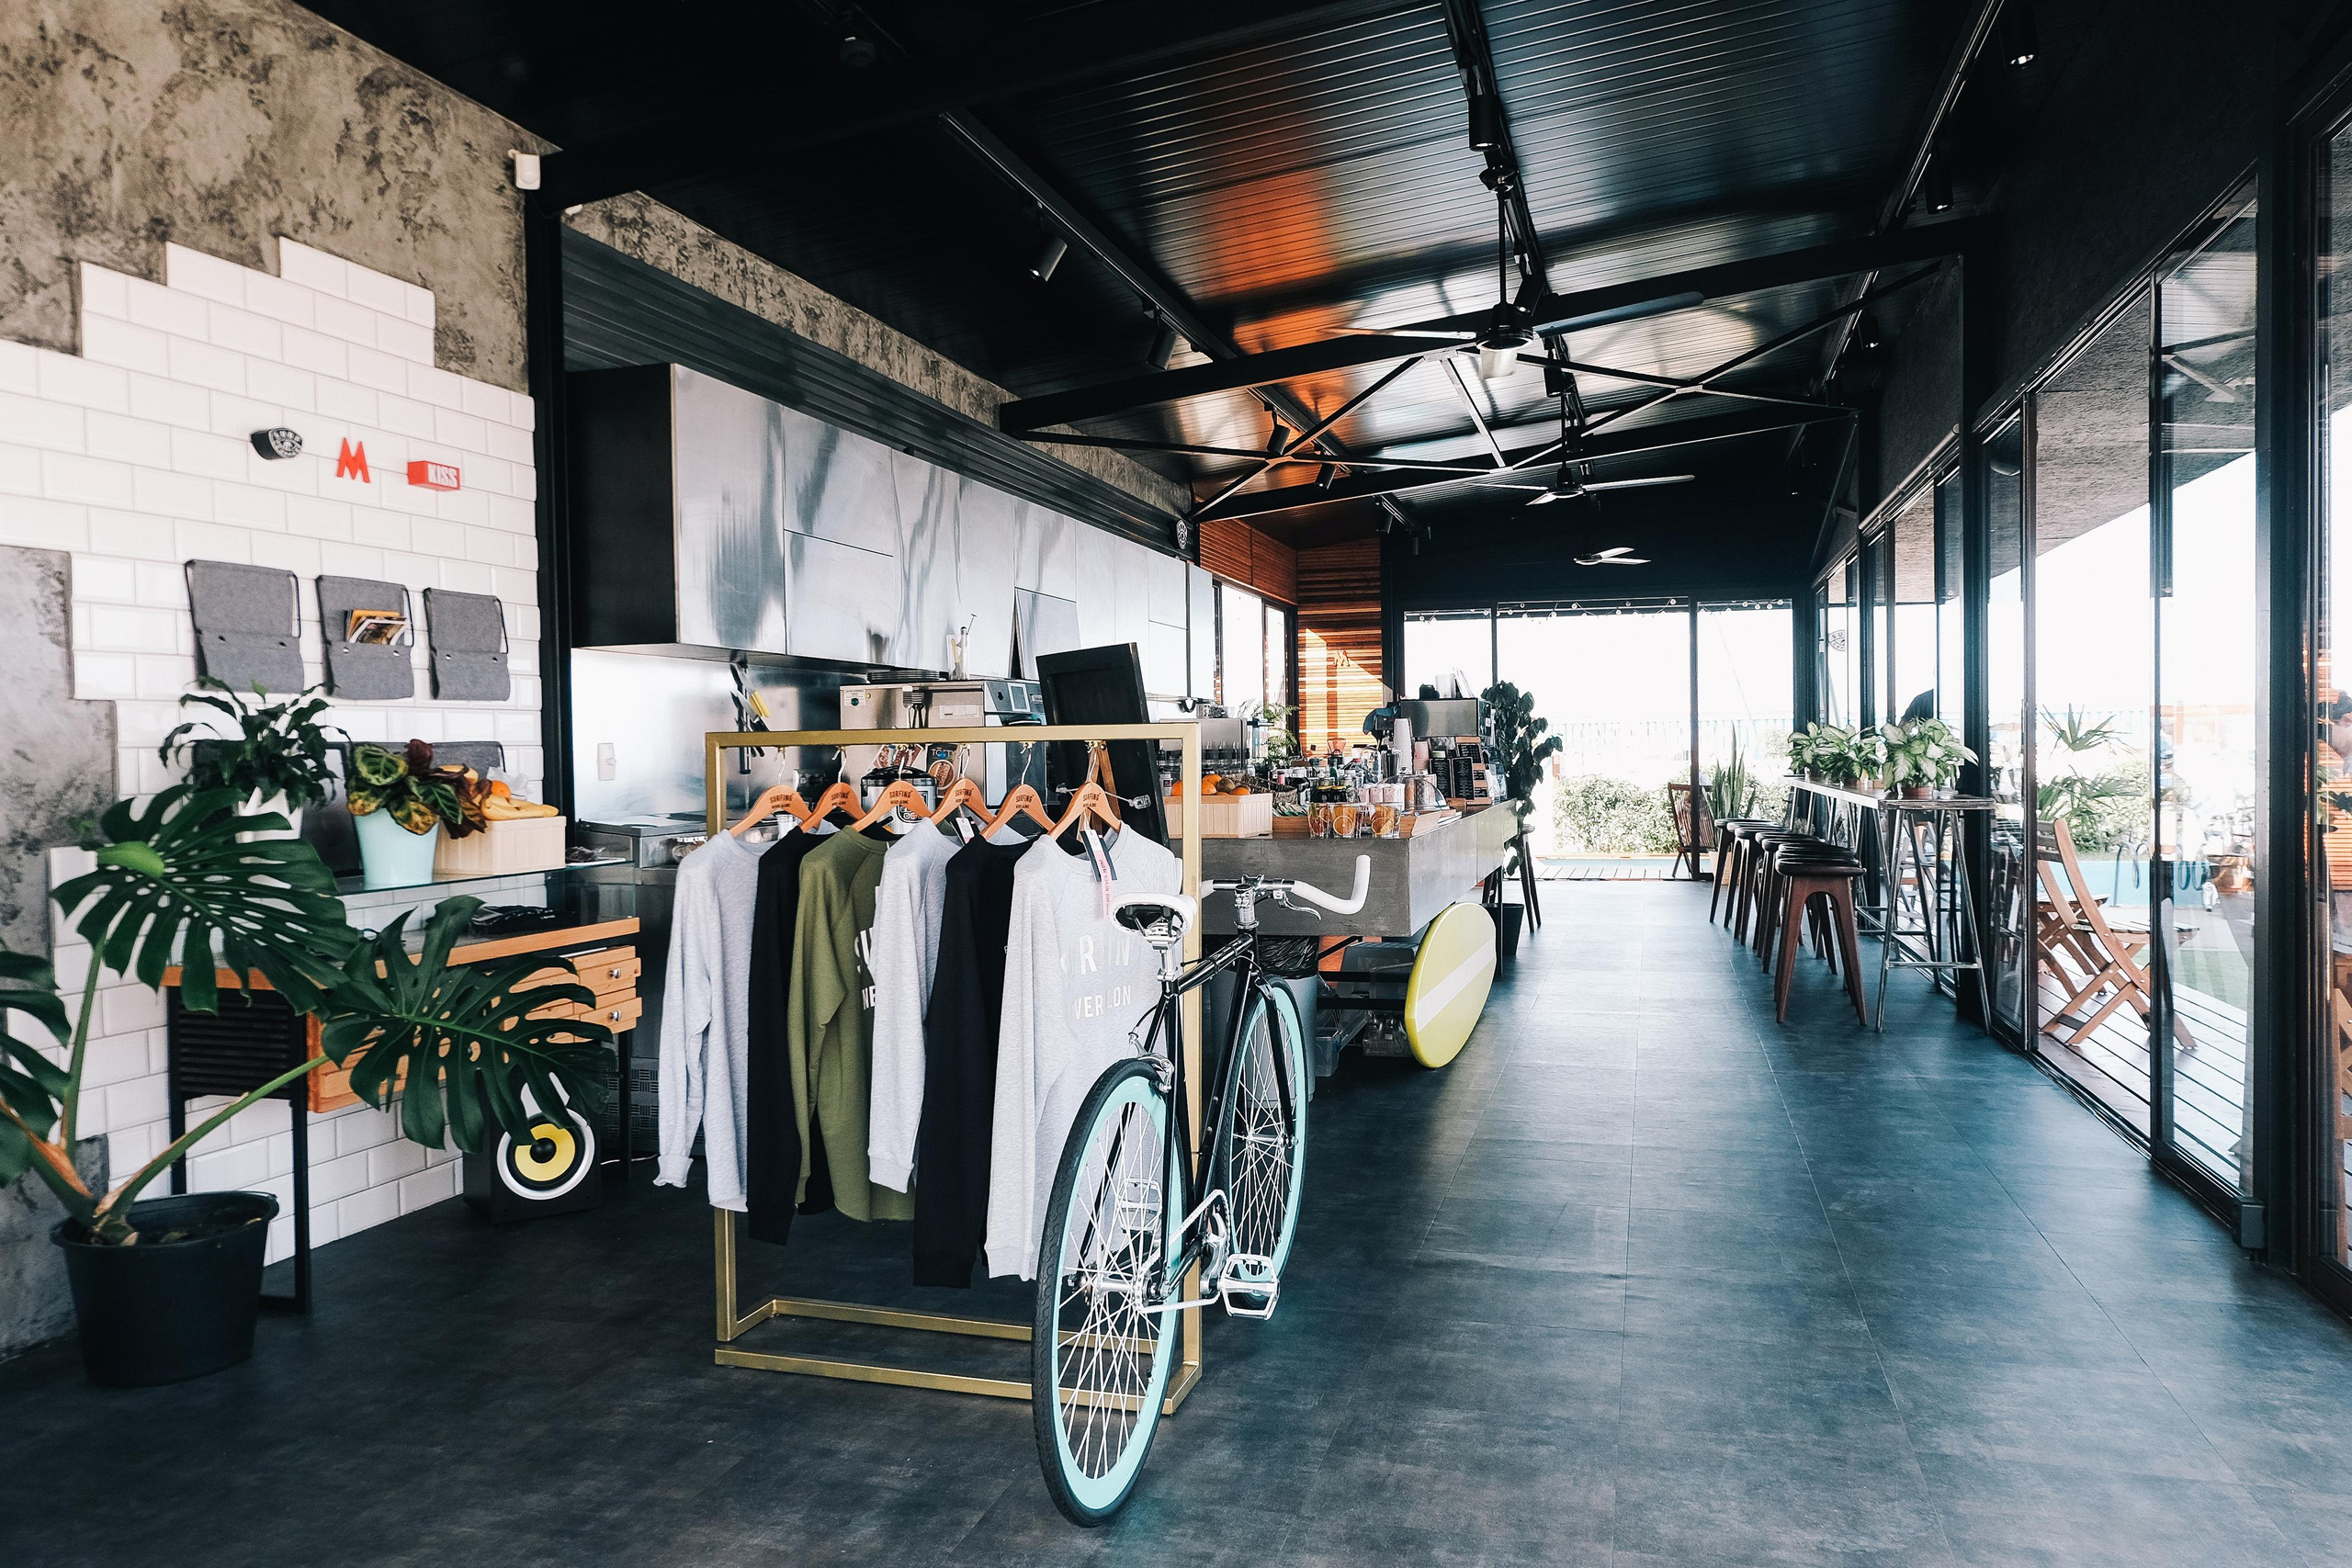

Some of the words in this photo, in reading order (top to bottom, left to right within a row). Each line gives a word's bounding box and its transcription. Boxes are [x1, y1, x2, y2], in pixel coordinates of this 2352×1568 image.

[336, 437, 370, 483] M
[428, 463, 458, 488] KISS
[889, 790, 911, 798] SURFING
